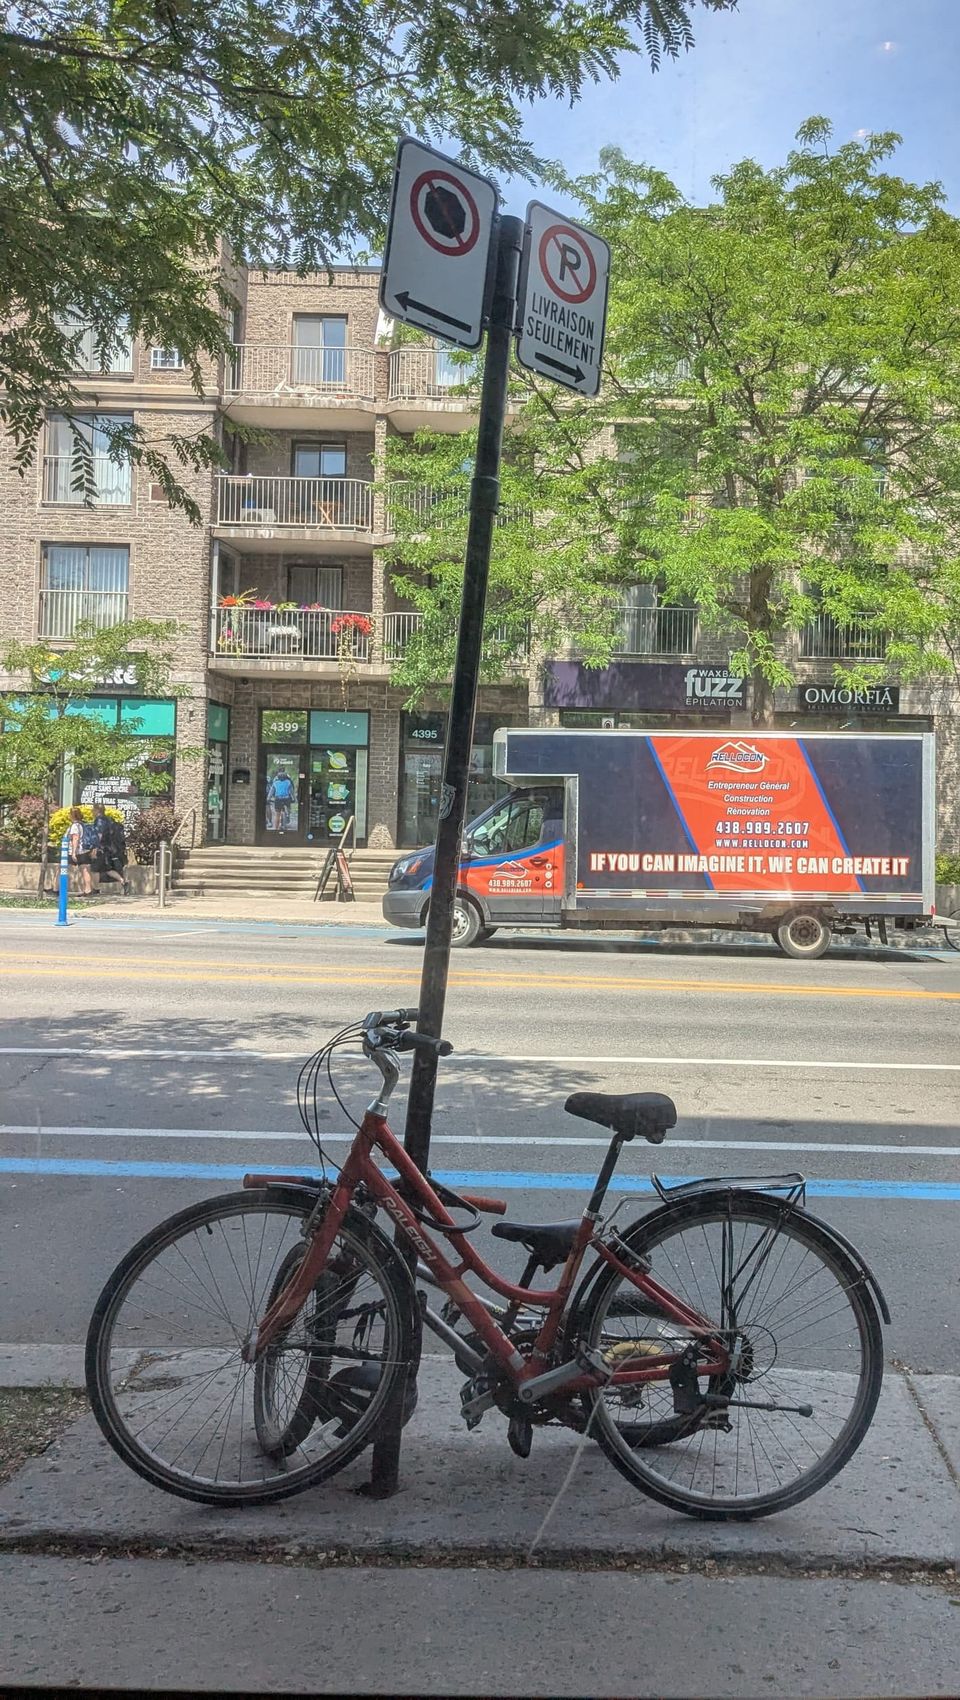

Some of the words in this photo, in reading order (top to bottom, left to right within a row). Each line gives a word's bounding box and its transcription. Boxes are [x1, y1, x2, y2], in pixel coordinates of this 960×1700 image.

[559, 243, 582, 281] P
[531, 292, 595, 341] LIVRAISON
[526, 316, 595, 366] SEULEMENT
[684, 668, 743, 698] fuzz
[685, 697, 743, 707] ÉPILATION
[804, 687, 894, 705] OMORFIÁ
[270, 721, 299, 733] 4399
[411, 729, 438, 739] 4395
[711, 752, 764, 762] RELLOCON
[708, 781, 759, 791] Entrepreneur
[759, 781, 790, 790] Général
[724, 794, 774, 803] Construction
[726, 807, 771, 816] Rénovation
[715, 821, 810, 835] 438.989.2607
[715, 839, 809, 848] WWW.RELLOCON.COM
[590, 853, 606, 872] IF
[607, 853, 640, 872] YOU
[642, 854, 674, 872] CAN
[677, 854, 745, 873] IMAGINE
[748, 855, 767, 875] IT,
[768, 856, 793, 874] WE
[797, 856, 829, 874] CAN
[831, 857, 890, 875] CREATE
[892, 858, 909, 876] IT
[382, 1196, 437, 1261] RALEIGH
